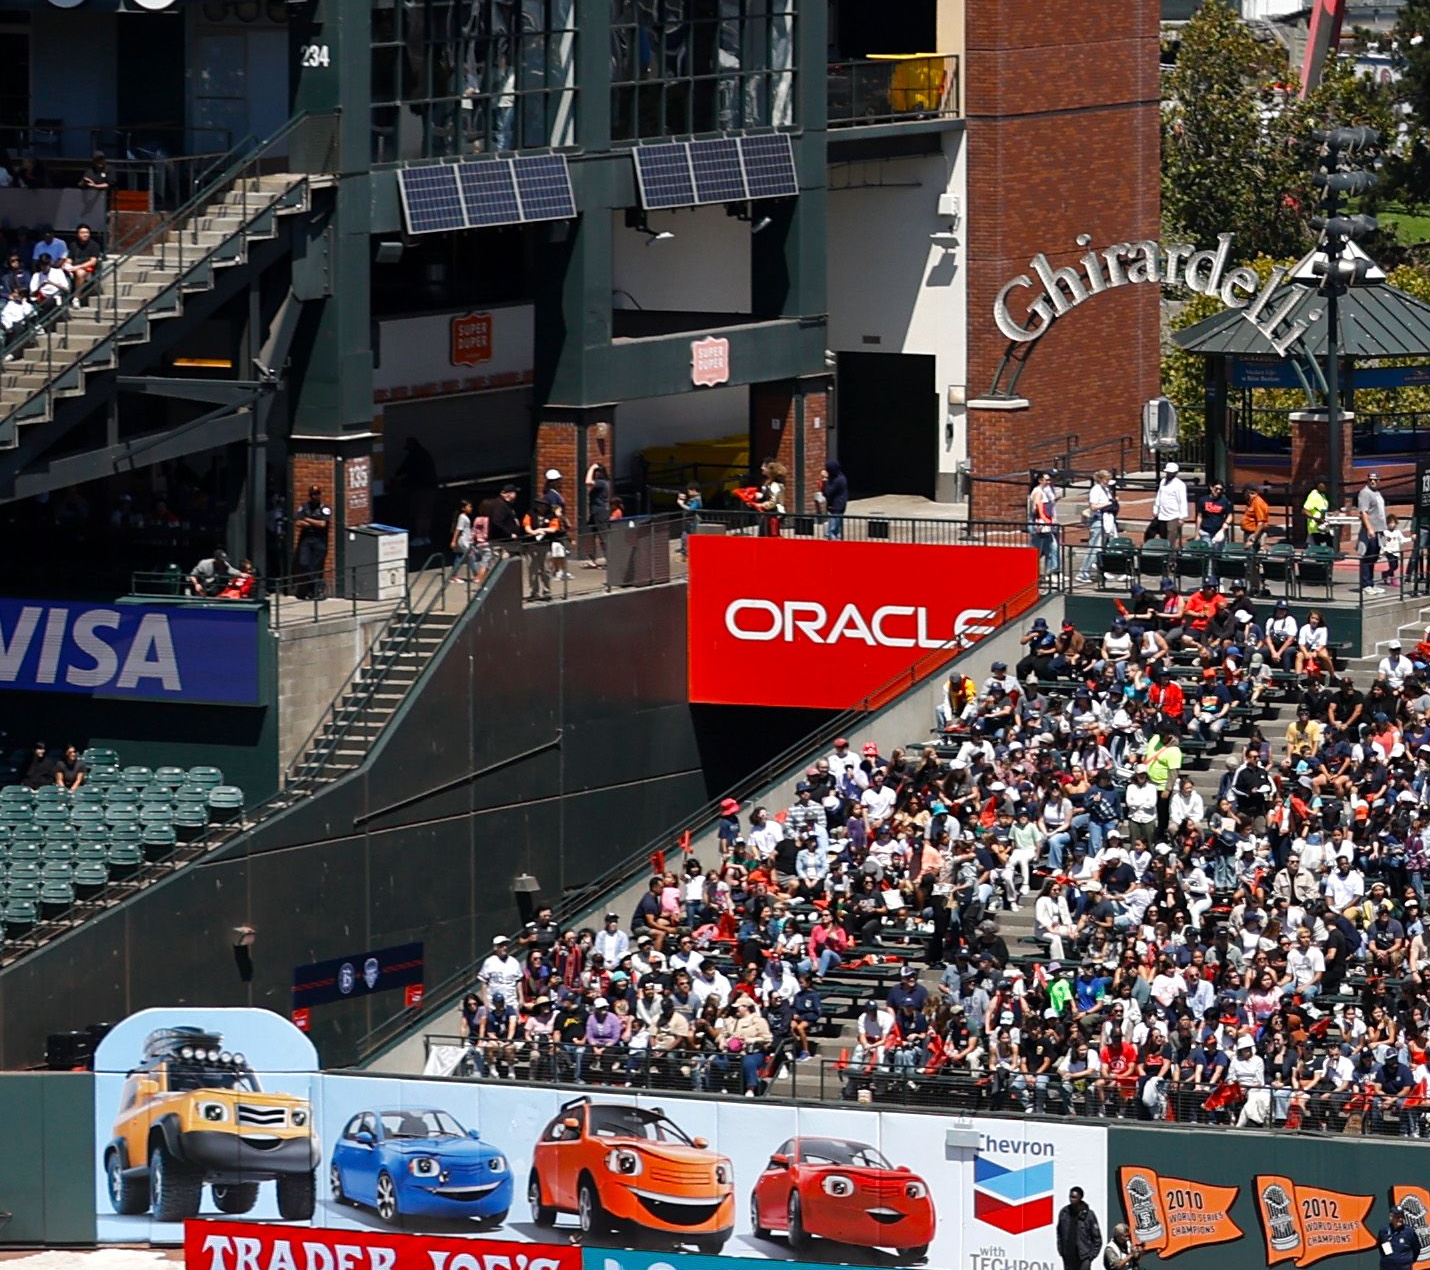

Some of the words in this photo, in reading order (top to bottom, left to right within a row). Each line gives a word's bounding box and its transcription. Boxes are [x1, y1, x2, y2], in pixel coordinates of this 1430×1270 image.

[300, 45, 329, 68] 234
[993, 232, 1323, 356] Ghirardelli
[458, 323, 488, 337] SUPER
[458, 335, 488, 350] DUPER
[698, 345, 724, 358] SUPER
[698, 357, 724, 371] DUPER
[724, 598, 999, 650] ORACLE
[1167, 1190, 1204, 1212] 2010
[1302, 1200, 1339, 1220] 2012
[1168, 1213, 1198, 1225] WORLD
[1199, 1211, 1225, 1223] SERIES
[1170, 1225, 1217, 1238] CHAMPIONS
[1304, 1222, 1334, 1234] WORLD
[1335, 1220, 1361, 1233] SERIES
[1306, 1234, 1352, 1247] CHAMPIONS
[979, 1246, 1005, 1260] with
